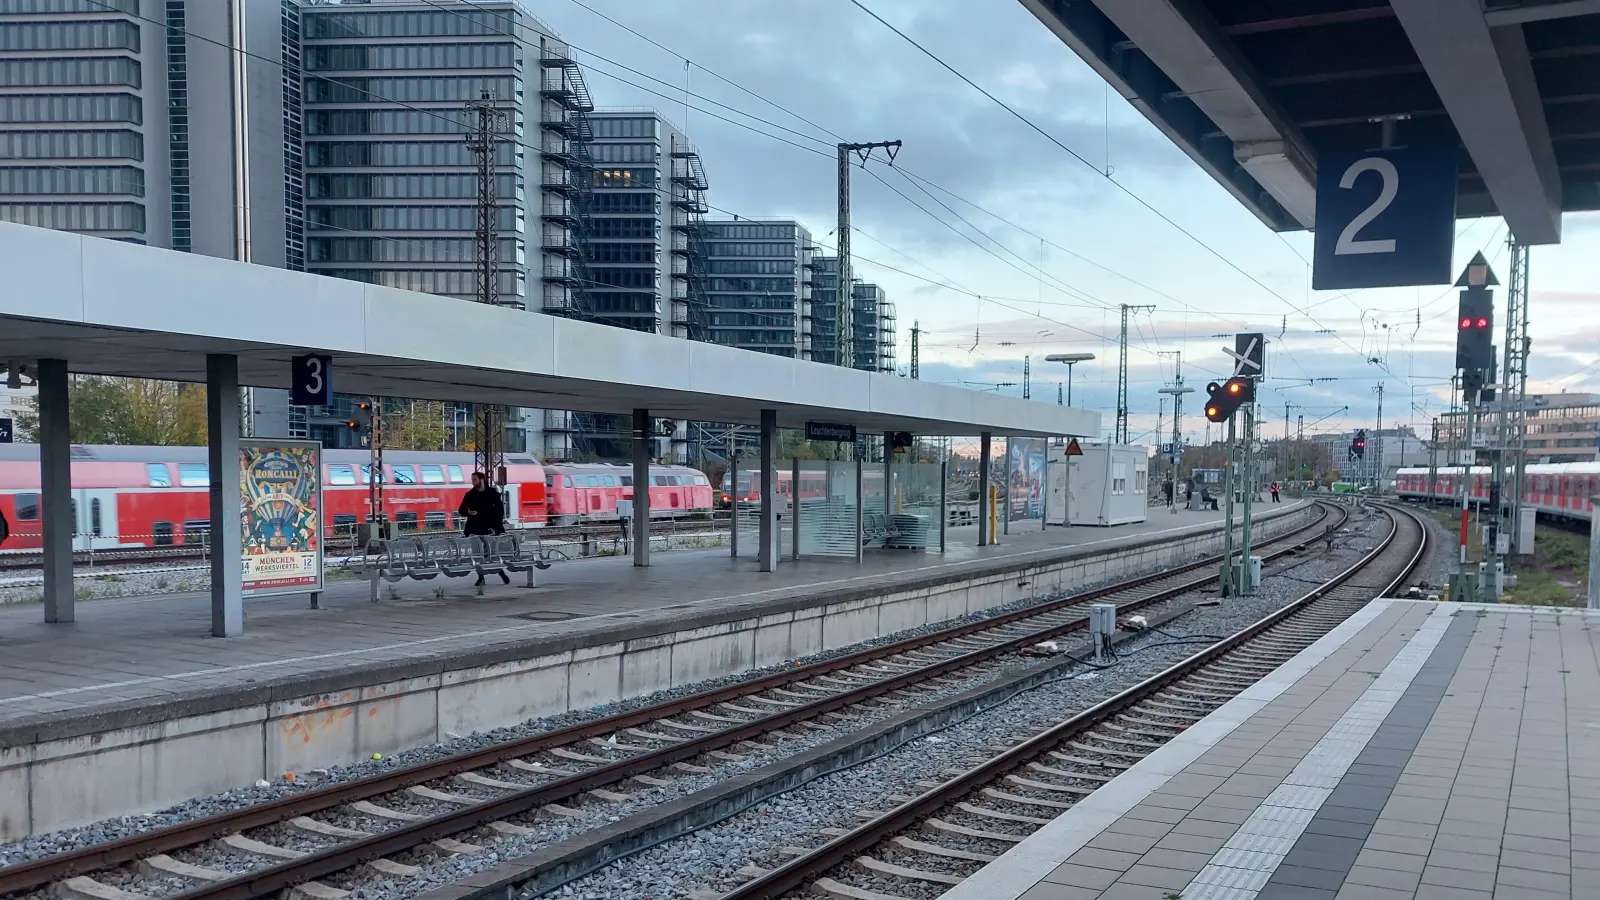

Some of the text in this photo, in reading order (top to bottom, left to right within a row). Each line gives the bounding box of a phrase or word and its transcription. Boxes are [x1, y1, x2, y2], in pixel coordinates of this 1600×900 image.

[1335, 157, 1399, 255] 2
[305, 357, 323, 394] 3
[811, 425, 850, 439] Leuchtenbergring
[1163, 443, 1172, 453] B
[1464, 452, 1472, 461] H
[255, 469, 297, 479] RONCALLI
[259, 556, 295, 565] MÜNCHEN
[303, 558, 312, 566] 12
[241, 562, 250, 570] 14
[255, 564, 299, 572] WERKSVIERTEL
